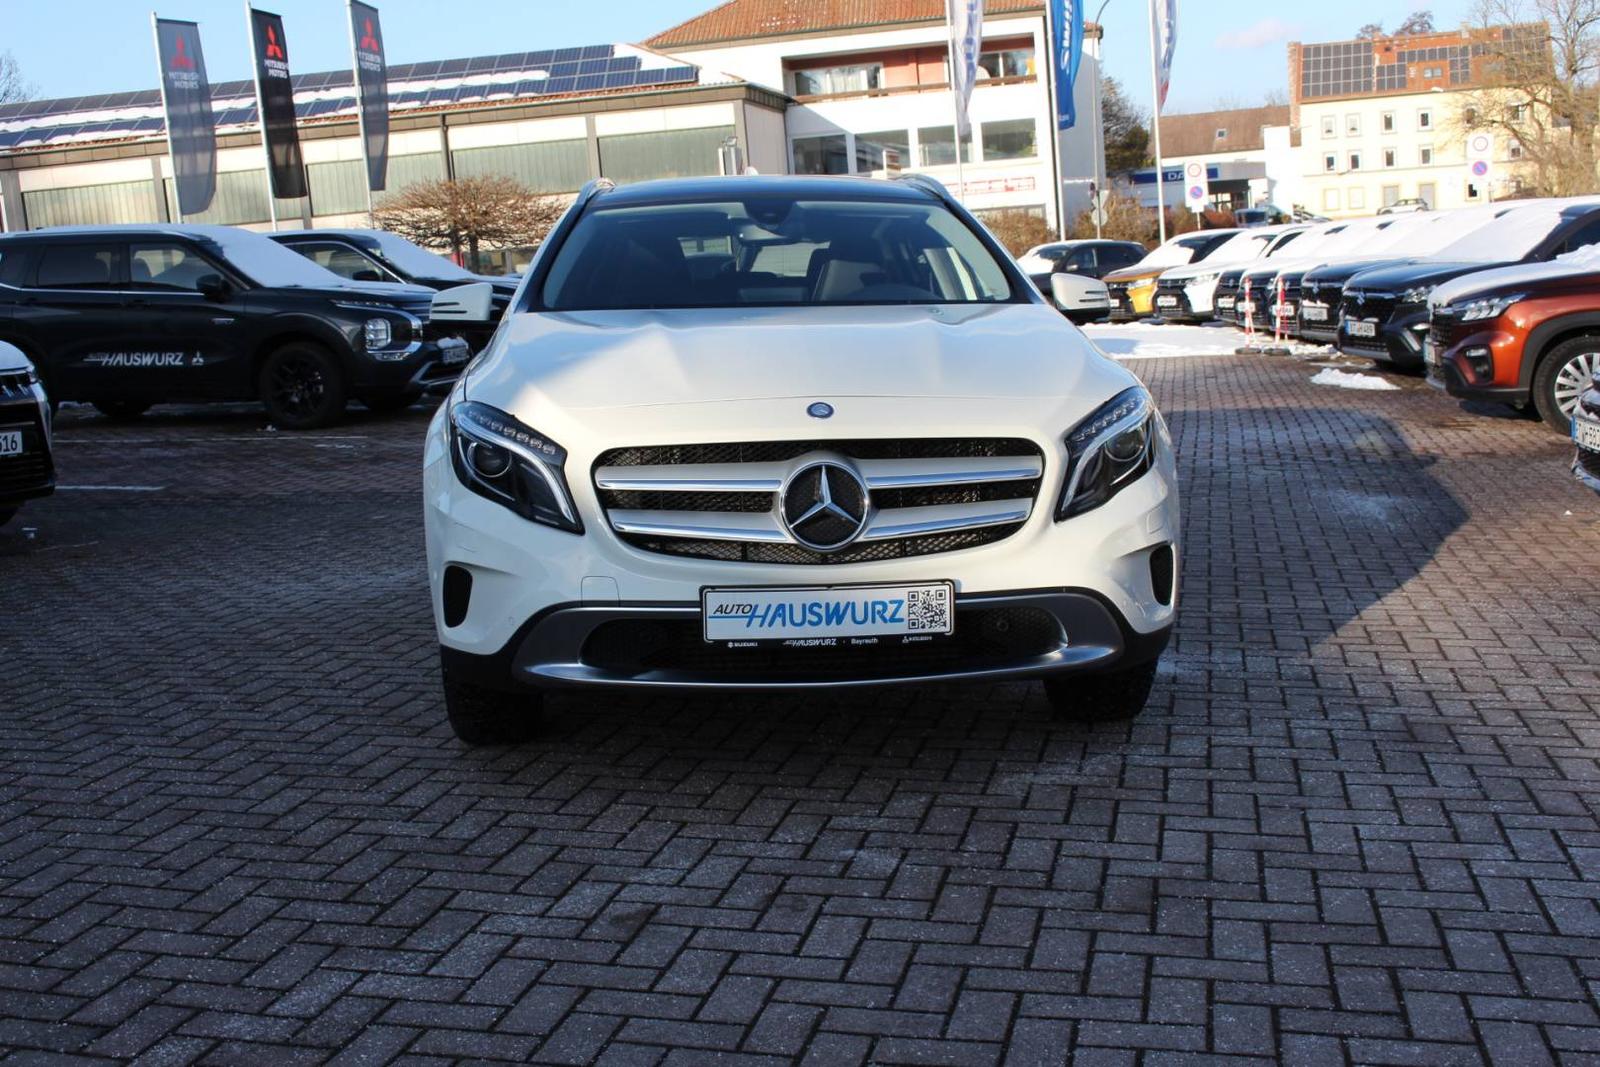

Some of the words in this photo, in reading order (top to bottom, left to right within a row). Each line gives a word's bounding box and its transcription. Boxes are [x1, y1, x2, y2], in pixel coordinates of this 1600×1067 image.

[102, 352, 183, 366] HAUSWURZ
[713, 603, 753, 615] AUTO
[746, 599, 904, 628] HAUSWURZ
